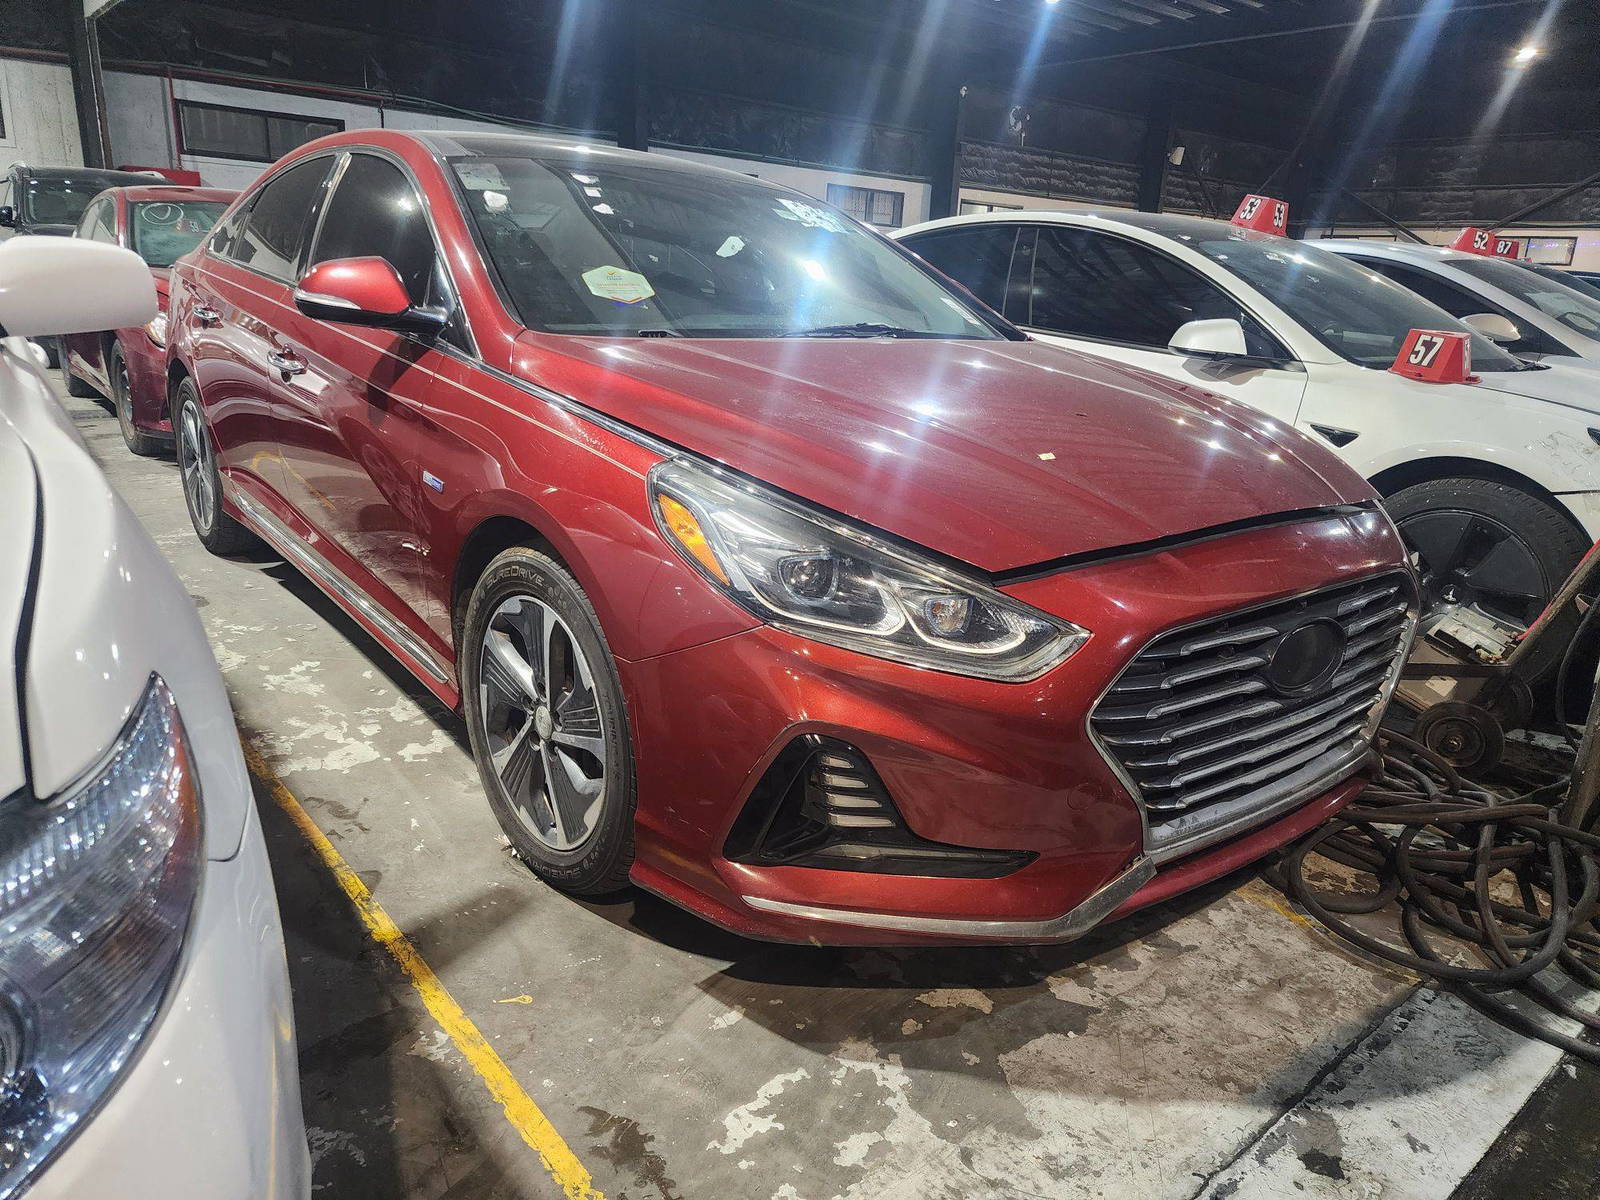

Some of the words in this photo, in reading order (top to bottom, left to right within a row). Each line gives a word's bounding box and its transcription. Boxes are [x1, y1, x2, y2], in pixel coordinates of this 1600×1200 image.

[1240, 198, 1262, 220] 53
[1274, 203, 1285, 228] 53
[1473, 231, 1489, 250] 52
[1496, 240, 1512, 254] 87
[1409, 334, 1445, 366] 57
[486, 565, 545, 589] SUREDRIVE
